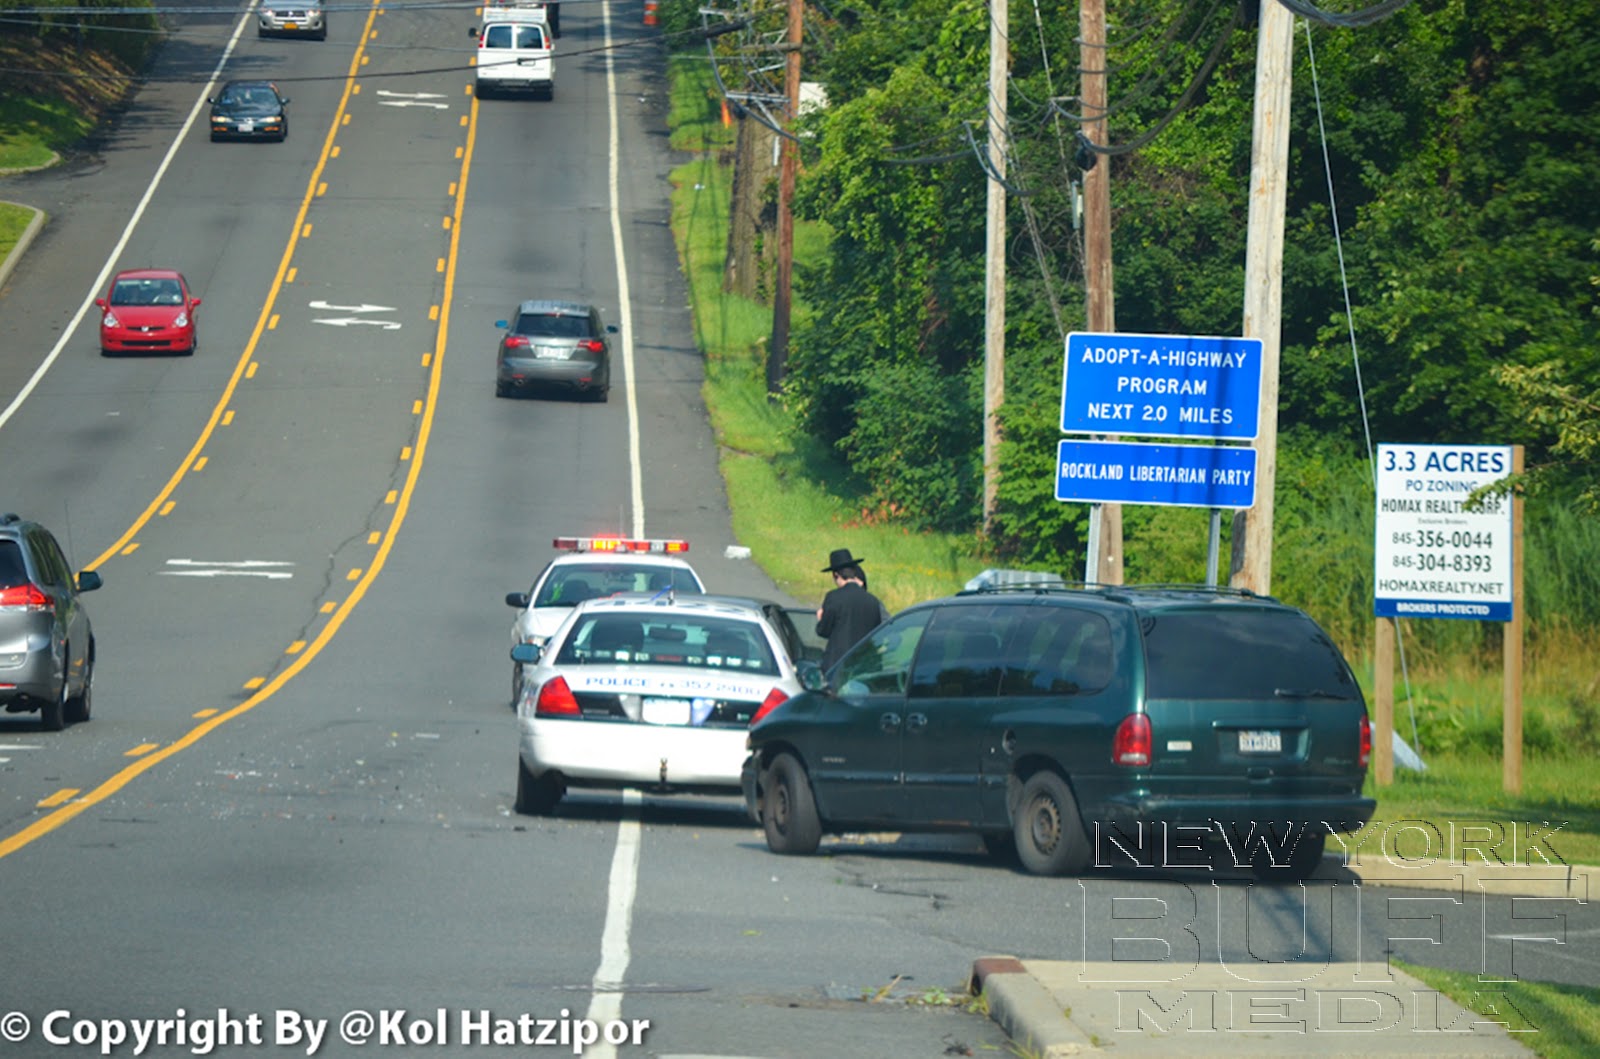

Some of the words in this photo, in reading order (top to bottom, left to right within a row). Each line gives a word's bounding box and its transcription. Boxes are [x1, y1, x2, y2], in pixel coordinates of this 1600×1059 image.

[1081, 347, 1247, 368] ADOPT-A-HIGHWAY
[1117, 377, 1207, 395] PROGRAM
[1087, 402, 1134, 420] NEXT
[1179, 407, 1233, 424] MILES
[1384, 450, 1416, 472] 3.3
[1424, 452, 1504, 473] ACRES
[1061, 462, 1124, 480] ROCKLAND
[1130, 465, 1207, 484] LIBERTARIAN
[1212, 469, 1251, 486] PARTY
[1405, 479, 1423, 492] PO
[1381, 499, 1421, 513] HOMAX
[1392, 530, 1493, 548] 845-356-0044
[1392, 554, 1492, 572] 845-304-8393
[1379, 579, 1504, 595] HOMAXREALTY.NET
[1396, 602, 1437, 613] BROKERS
[1437, 603, 1490, 615] PROTECTED
[585, 677, 650, 687] POLICE
